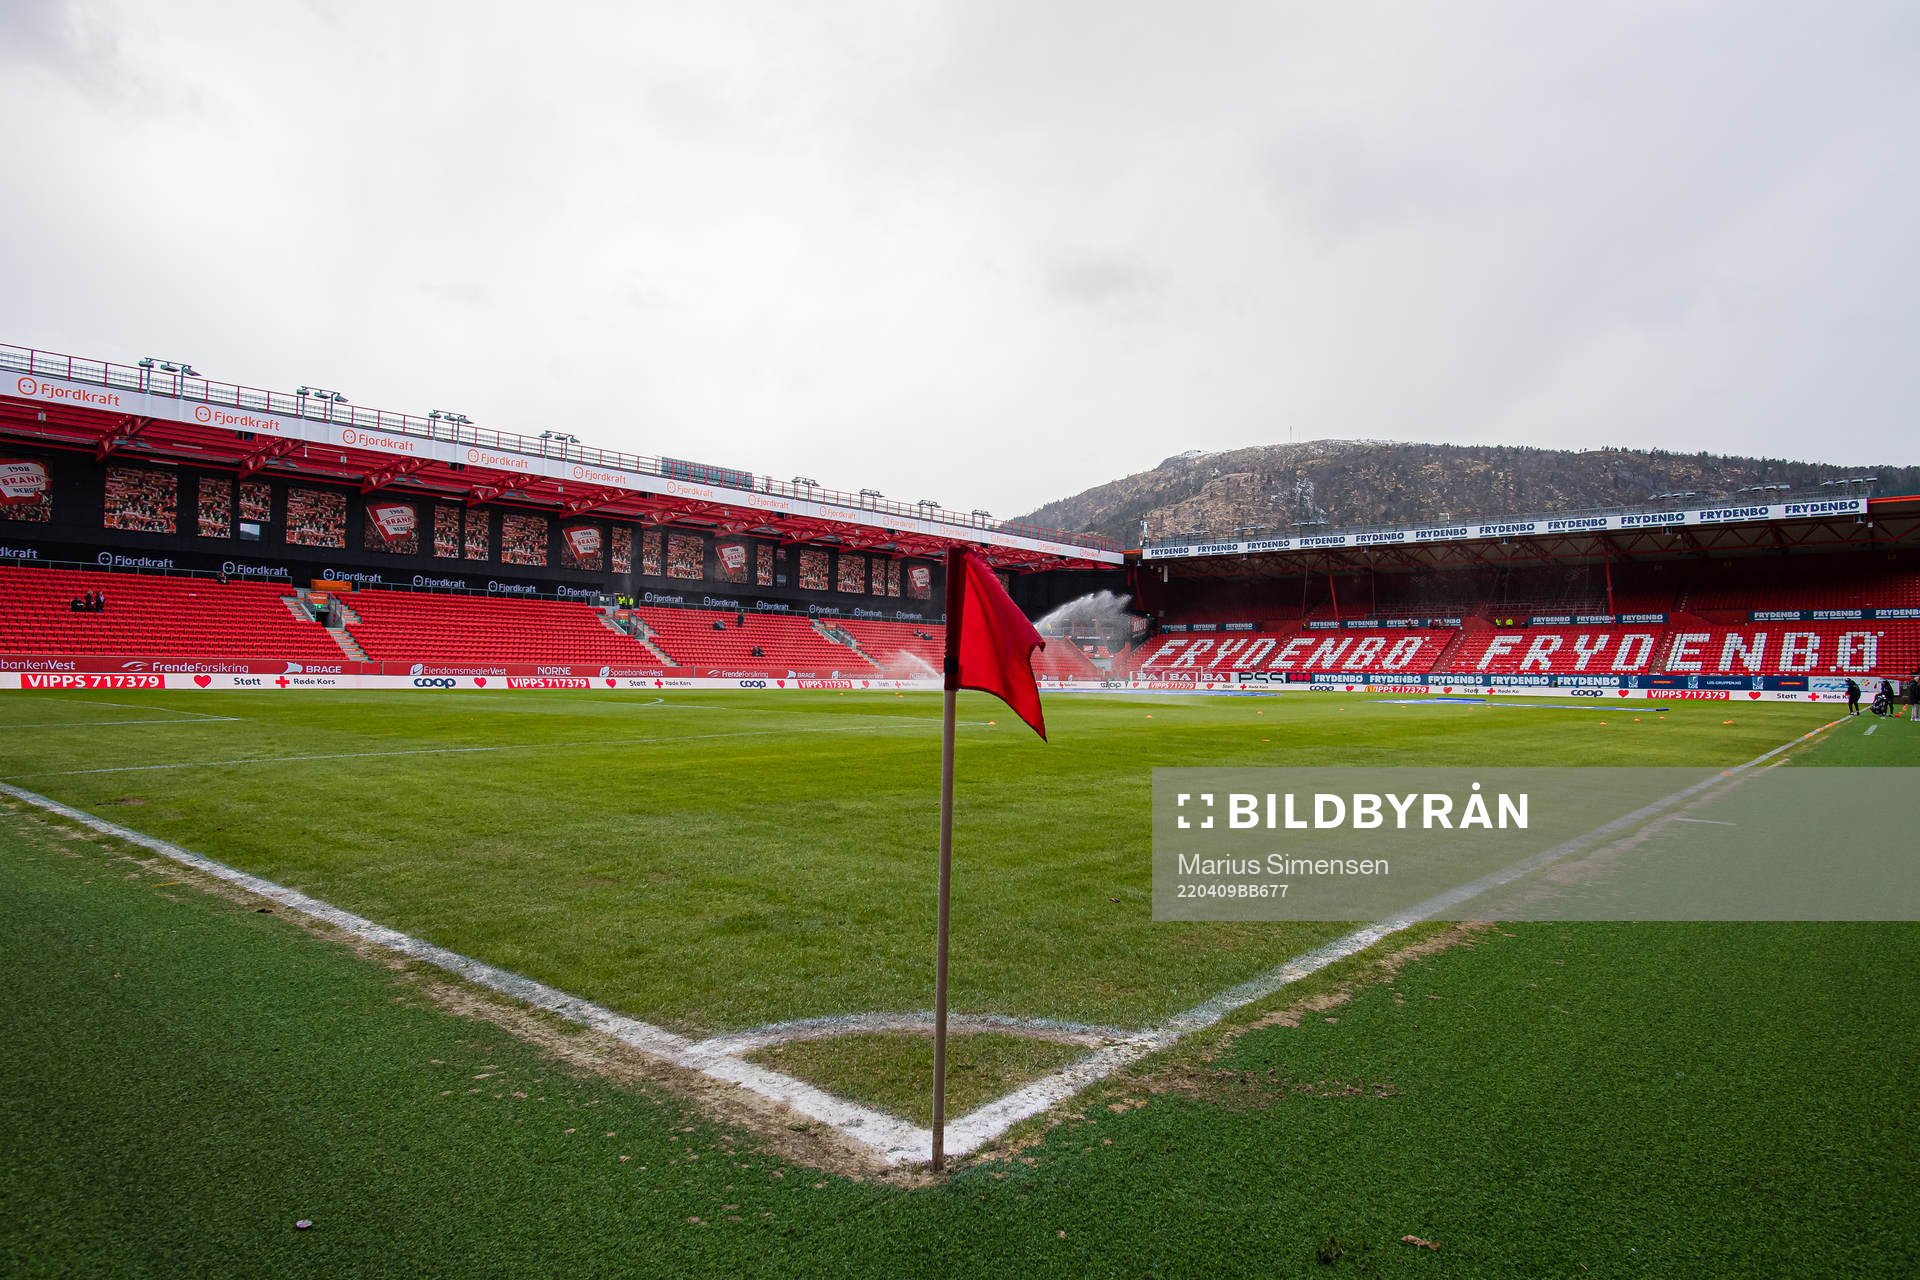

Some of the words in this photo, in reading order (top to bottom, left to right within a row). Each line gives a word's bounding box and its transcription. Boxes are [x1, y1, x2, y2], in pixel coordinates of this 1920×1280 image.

[41, 383, 120, 406] Fjordkraft
[214, 411, 280, 431] Fjordkraft
[359, 434, 414, 451] Fjordkraft
[481, 453, 528, 469] Fjordkraft
[1, 476, 43, 486] BRANN
[585, 470, 626, 484] Fjordkraft
[677, 484, 713, 498] Fjordkraft
[115, 555, 174, 568] Fjordkraft
[237, 564, 288, 576] Fjordkraft
[336, 571, 382, 582] Fjordkraft
[424, 577, 465, 588] Fjordkraft
[499, 583, 536, 593] Fjordkraft
[653, 593, 683, 603] Fjordkraft
[0, 659, 76, 670] bankenVest
[152, 661, 249, 674] FrendeForsikring
[305, 665, 342, 673] BRAGE
[423, 665, 506, 676] EiendomsmeglerVest
[537, 666, 571, 675] NORNE
[610, 669, 663, 678] SparebankenVest
[27, 674, 86, 688] VIPPS
[90, 675, 160, 688] 717379
[234, 677, 261, 686] Støtt
[1169, 672, 1192, 681] BA
[1202, 673, 1226, 682] BA
[510, 678, 545, 688] VIPPS
[546, 678, 587, 688] 717379
[800, 680, 823, 688] VIPPS
[824, 680, 850, 688] 717379
[1395, 685, 1427, 694] 717379
[1651, 691, 1682, 699] VIPPS
[1685, 691, 1726, 700] 717379
[1776, 692, 1798, 700] Støtt
